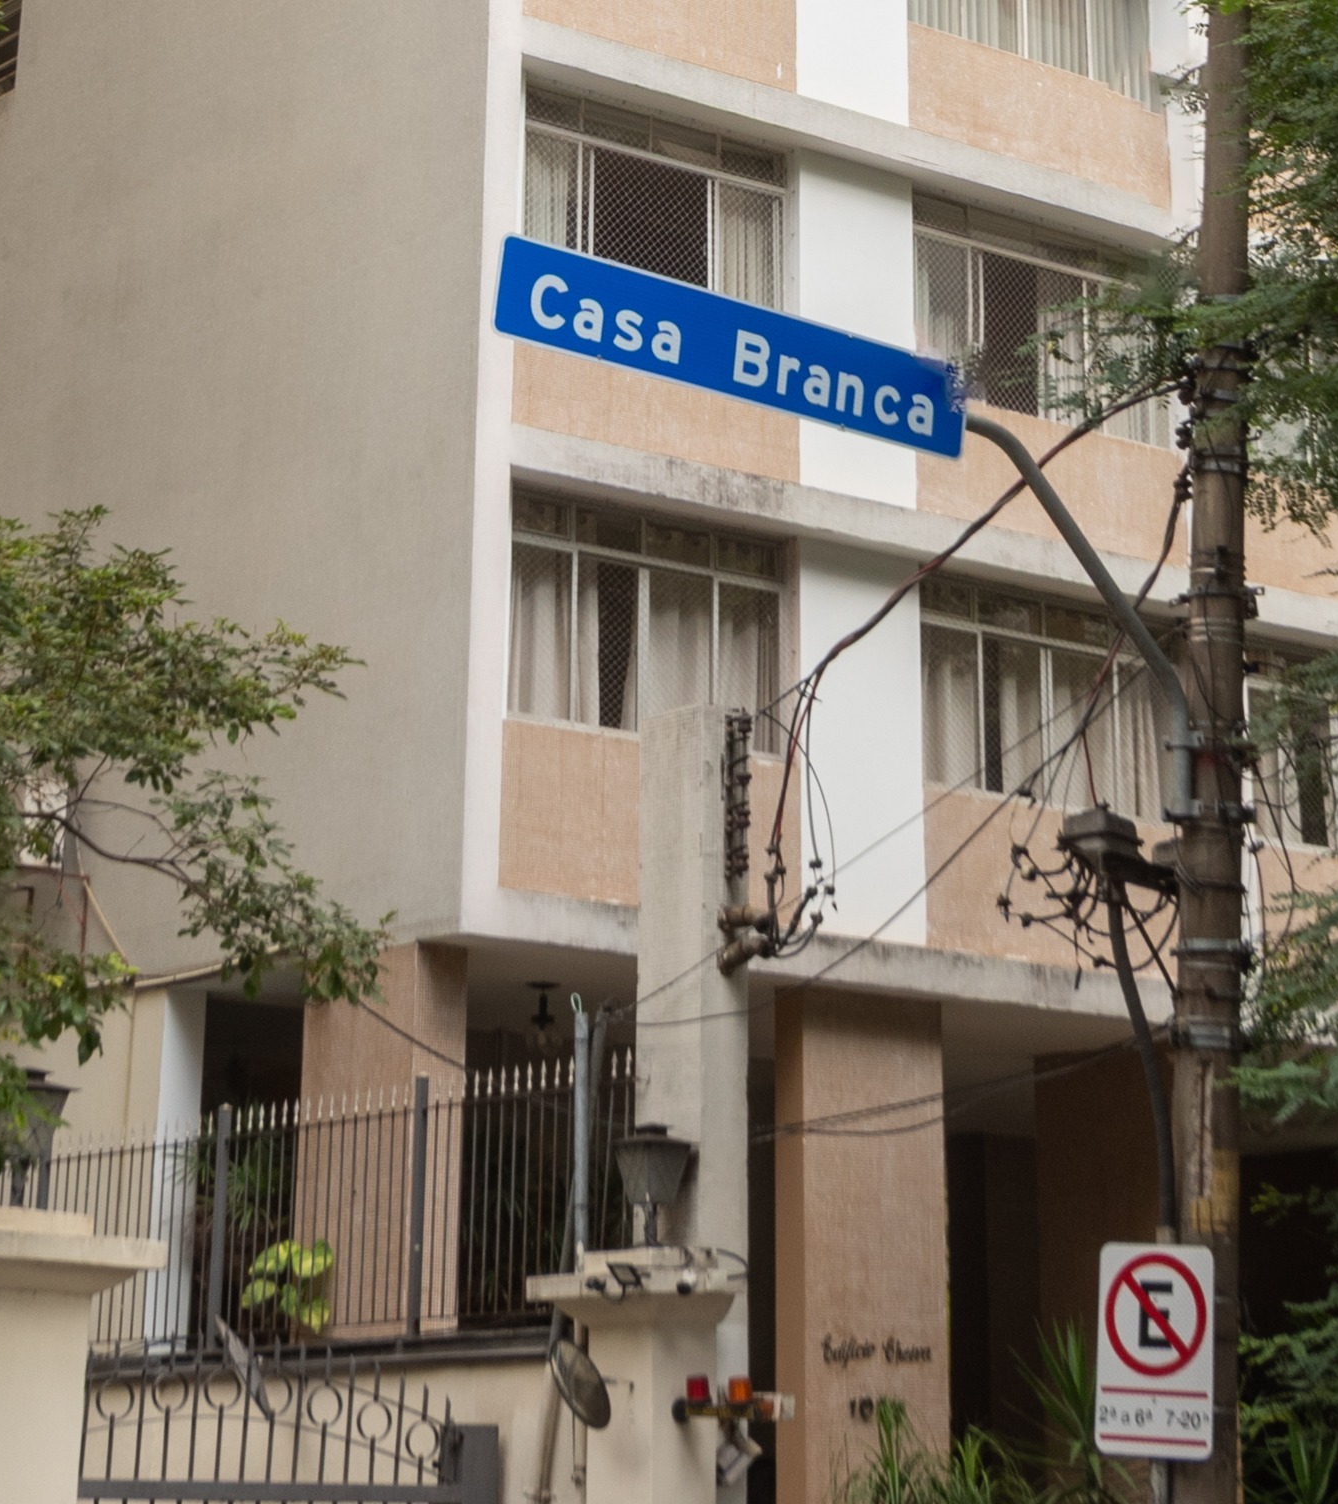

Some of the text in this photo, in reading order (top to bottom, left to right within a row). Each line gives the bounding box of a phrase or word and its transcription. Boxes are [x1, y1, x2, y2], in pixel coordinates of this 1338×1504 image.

[529, 273, 935, 437] Casa Branca
[1138, 1280, 1173, 1349] E
